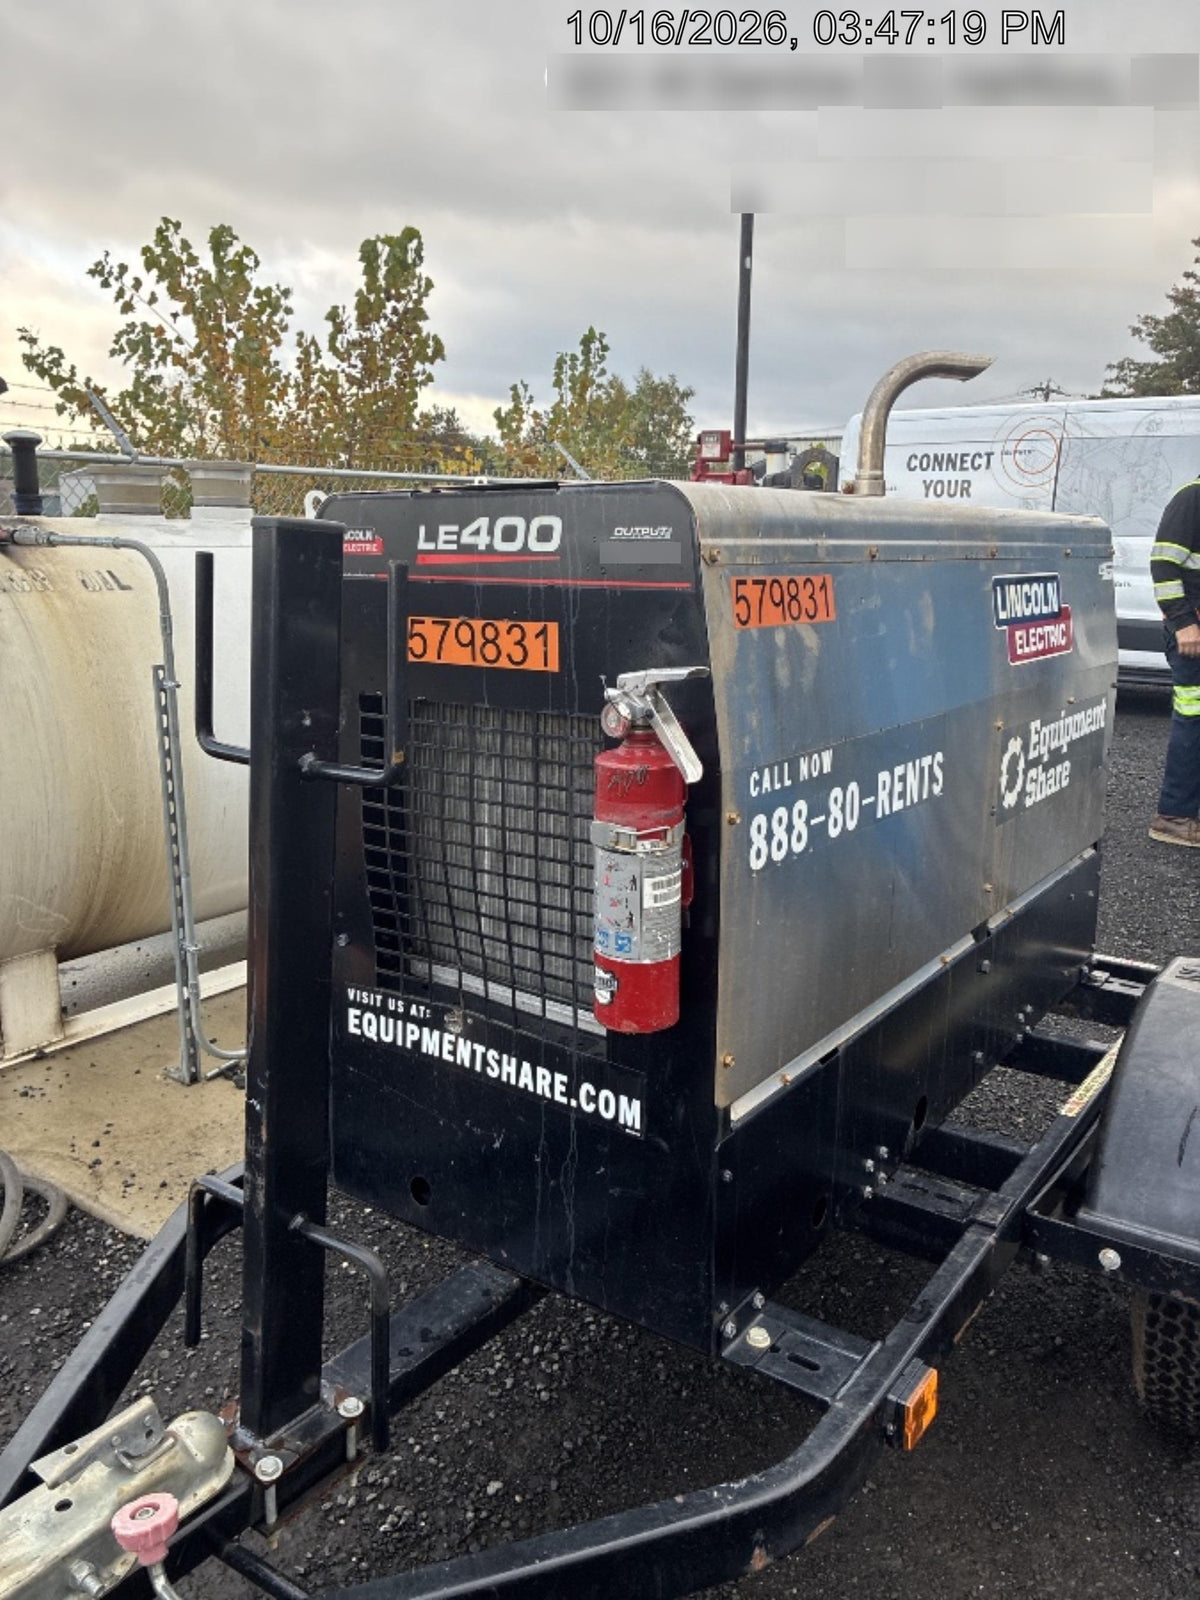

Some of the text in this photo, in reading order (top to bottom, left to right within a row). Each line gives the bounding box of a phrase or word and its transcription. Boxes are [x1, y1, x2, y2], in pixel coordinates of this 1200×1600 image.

[906, 451, 995, 472] CONNECT
[922, 479, 972, 498] YOUR
[417, 515, 563, 552] LE400
[614, 526, 668, 537] OUTPUT
[735, 575, 830, 626] 579831
[996, 580, 1059, 620] LINCOLN
[408, 618, 549, 668] 579831
[1014, 622, 1067, 655] ELECTRIC
[1027, 697, 1107, 762] Equipment
[749, 748, 833, 798] CALL NOW
[1025, 760, 1071, 808] Share
[749, 751, 944, 871] 888-80-RENTS
[347, 987, 431, 1019] VISIT US AT:
[347, 1006, 642, 1130] EQUIPMENTSHARE.COM
